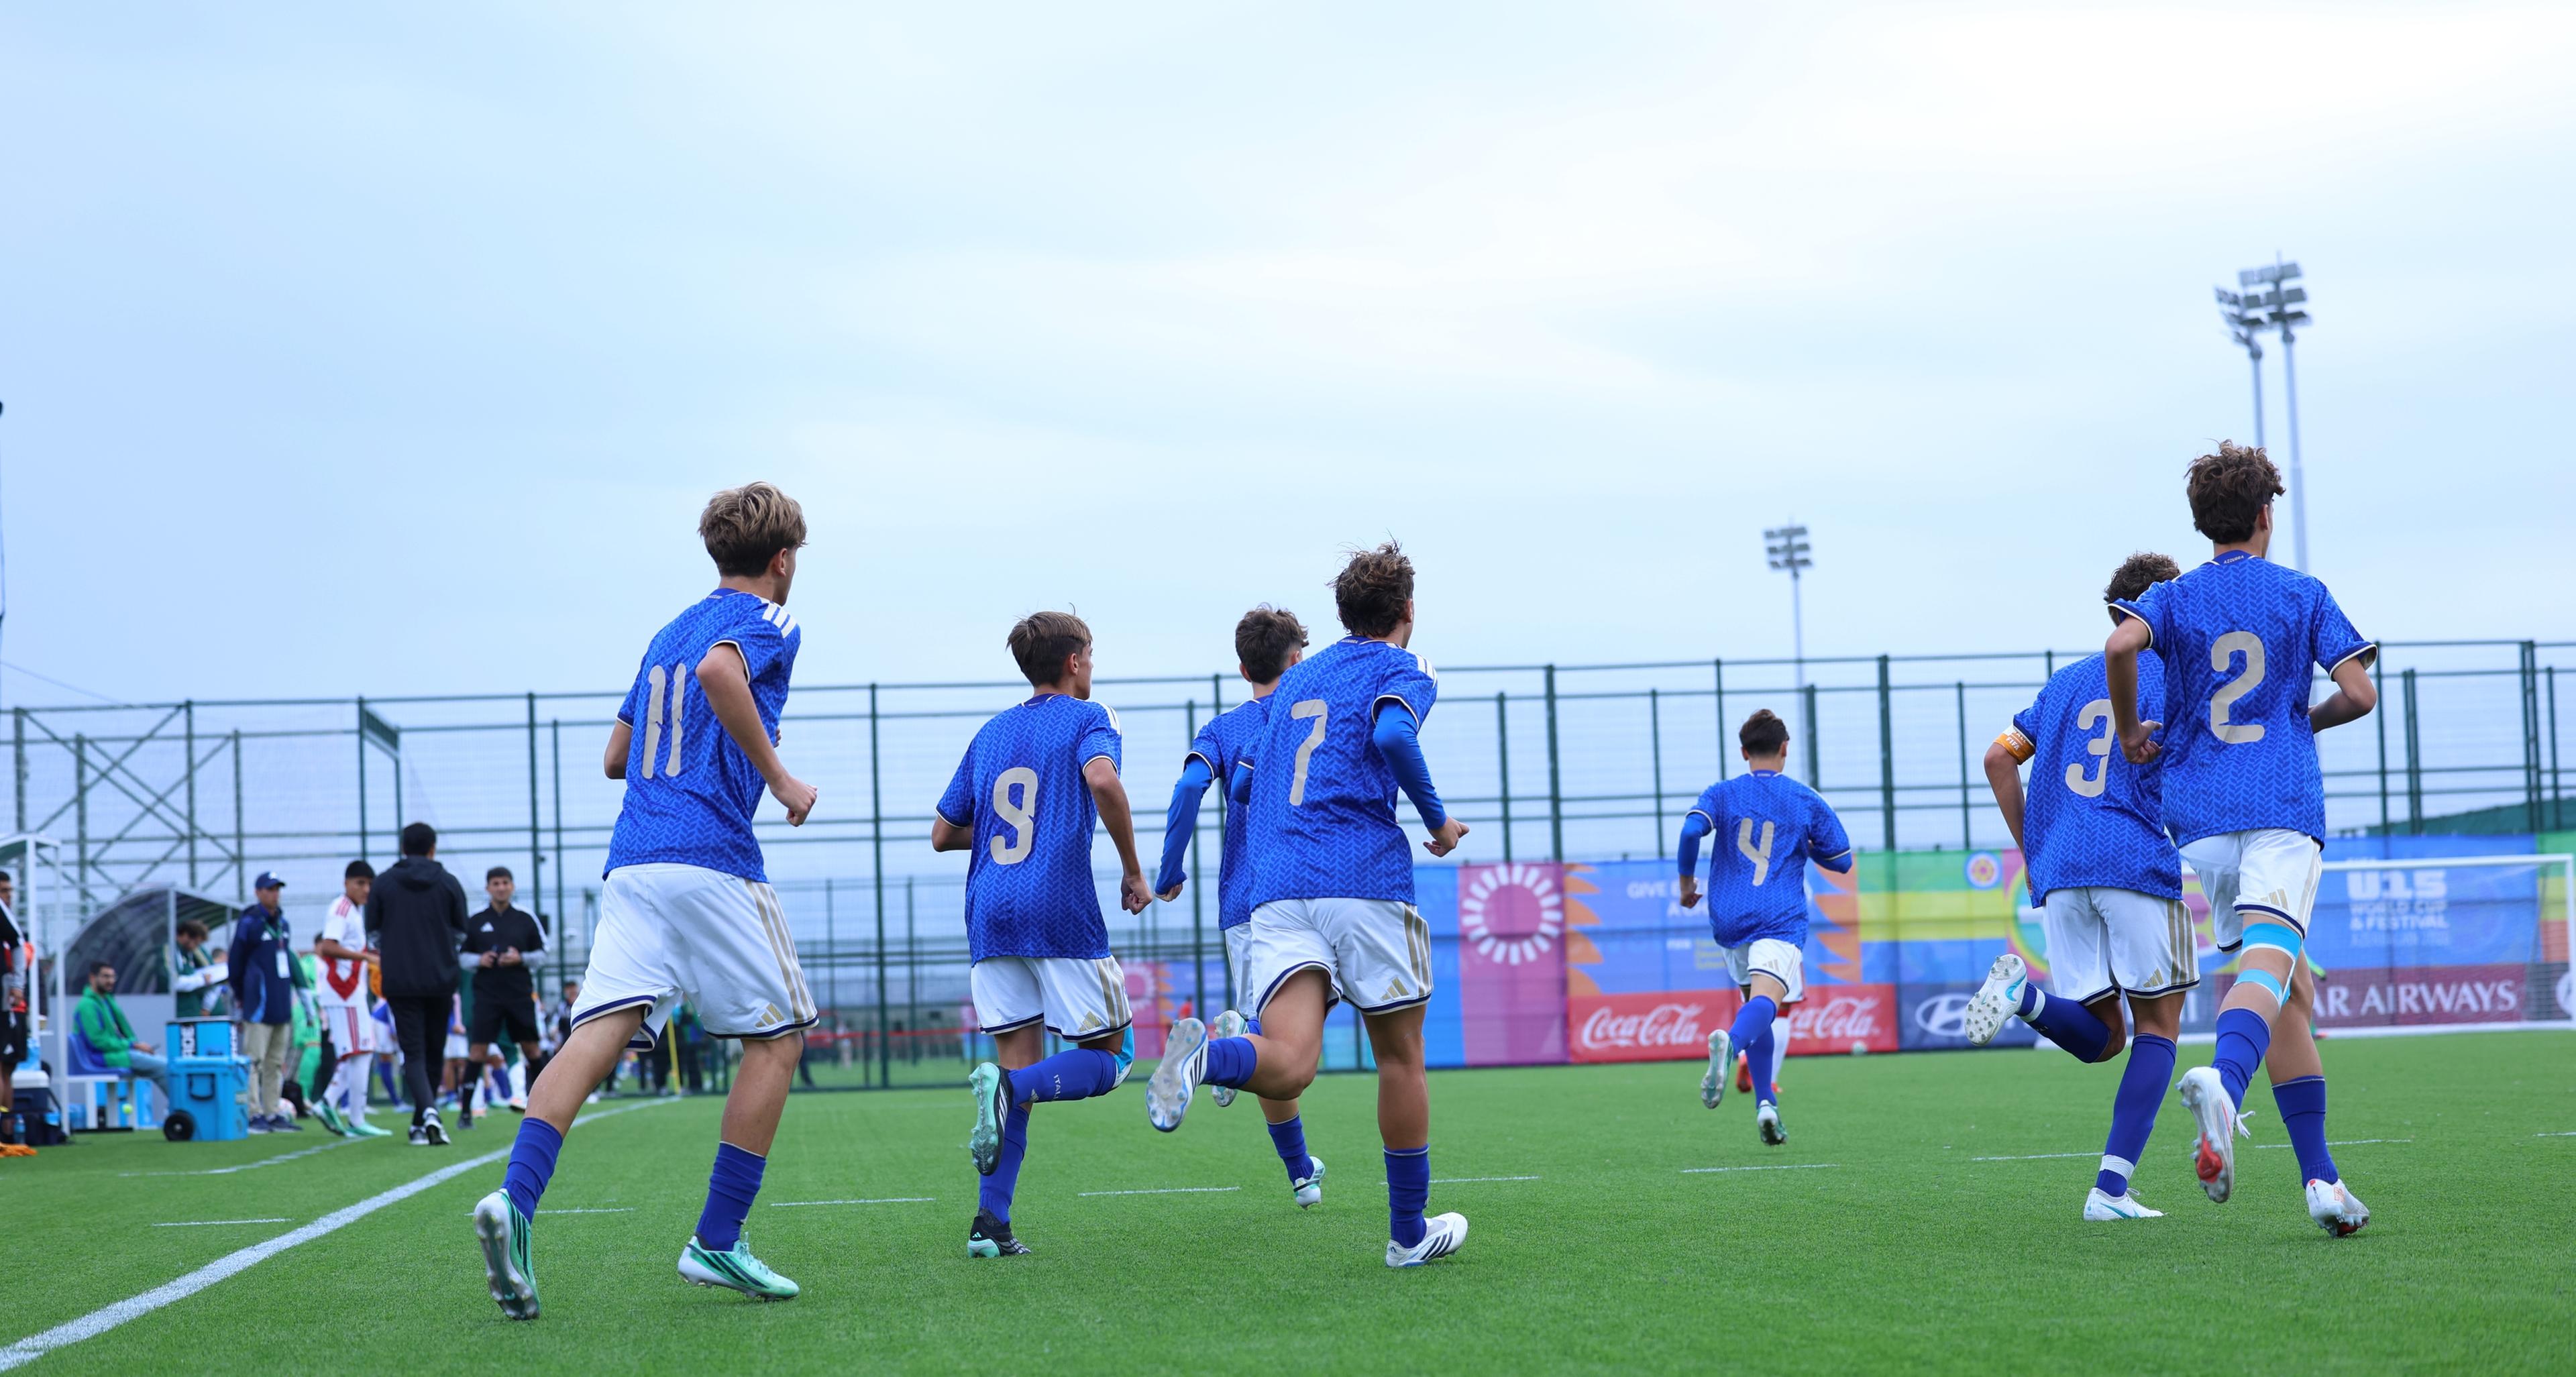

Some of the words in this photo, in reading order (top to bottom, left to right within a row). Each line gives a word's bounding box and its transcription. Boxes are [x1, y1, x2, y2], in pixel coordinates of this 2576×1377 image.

[641, 663, 687, 779] 11
[2210, 630, 2265, 744] 2
[1289, 699, 1328, 806] 7
[2006, 737, 2019, 751] FIFA
[2065, 698, 2116, 797] 3
[989, 767, 1038, 865] 9
[1737, 818, 1775, 887] 4
[2346, 869, 2449, 900] U15
[2360, 979, 2518, 1016] AIRWAYS
